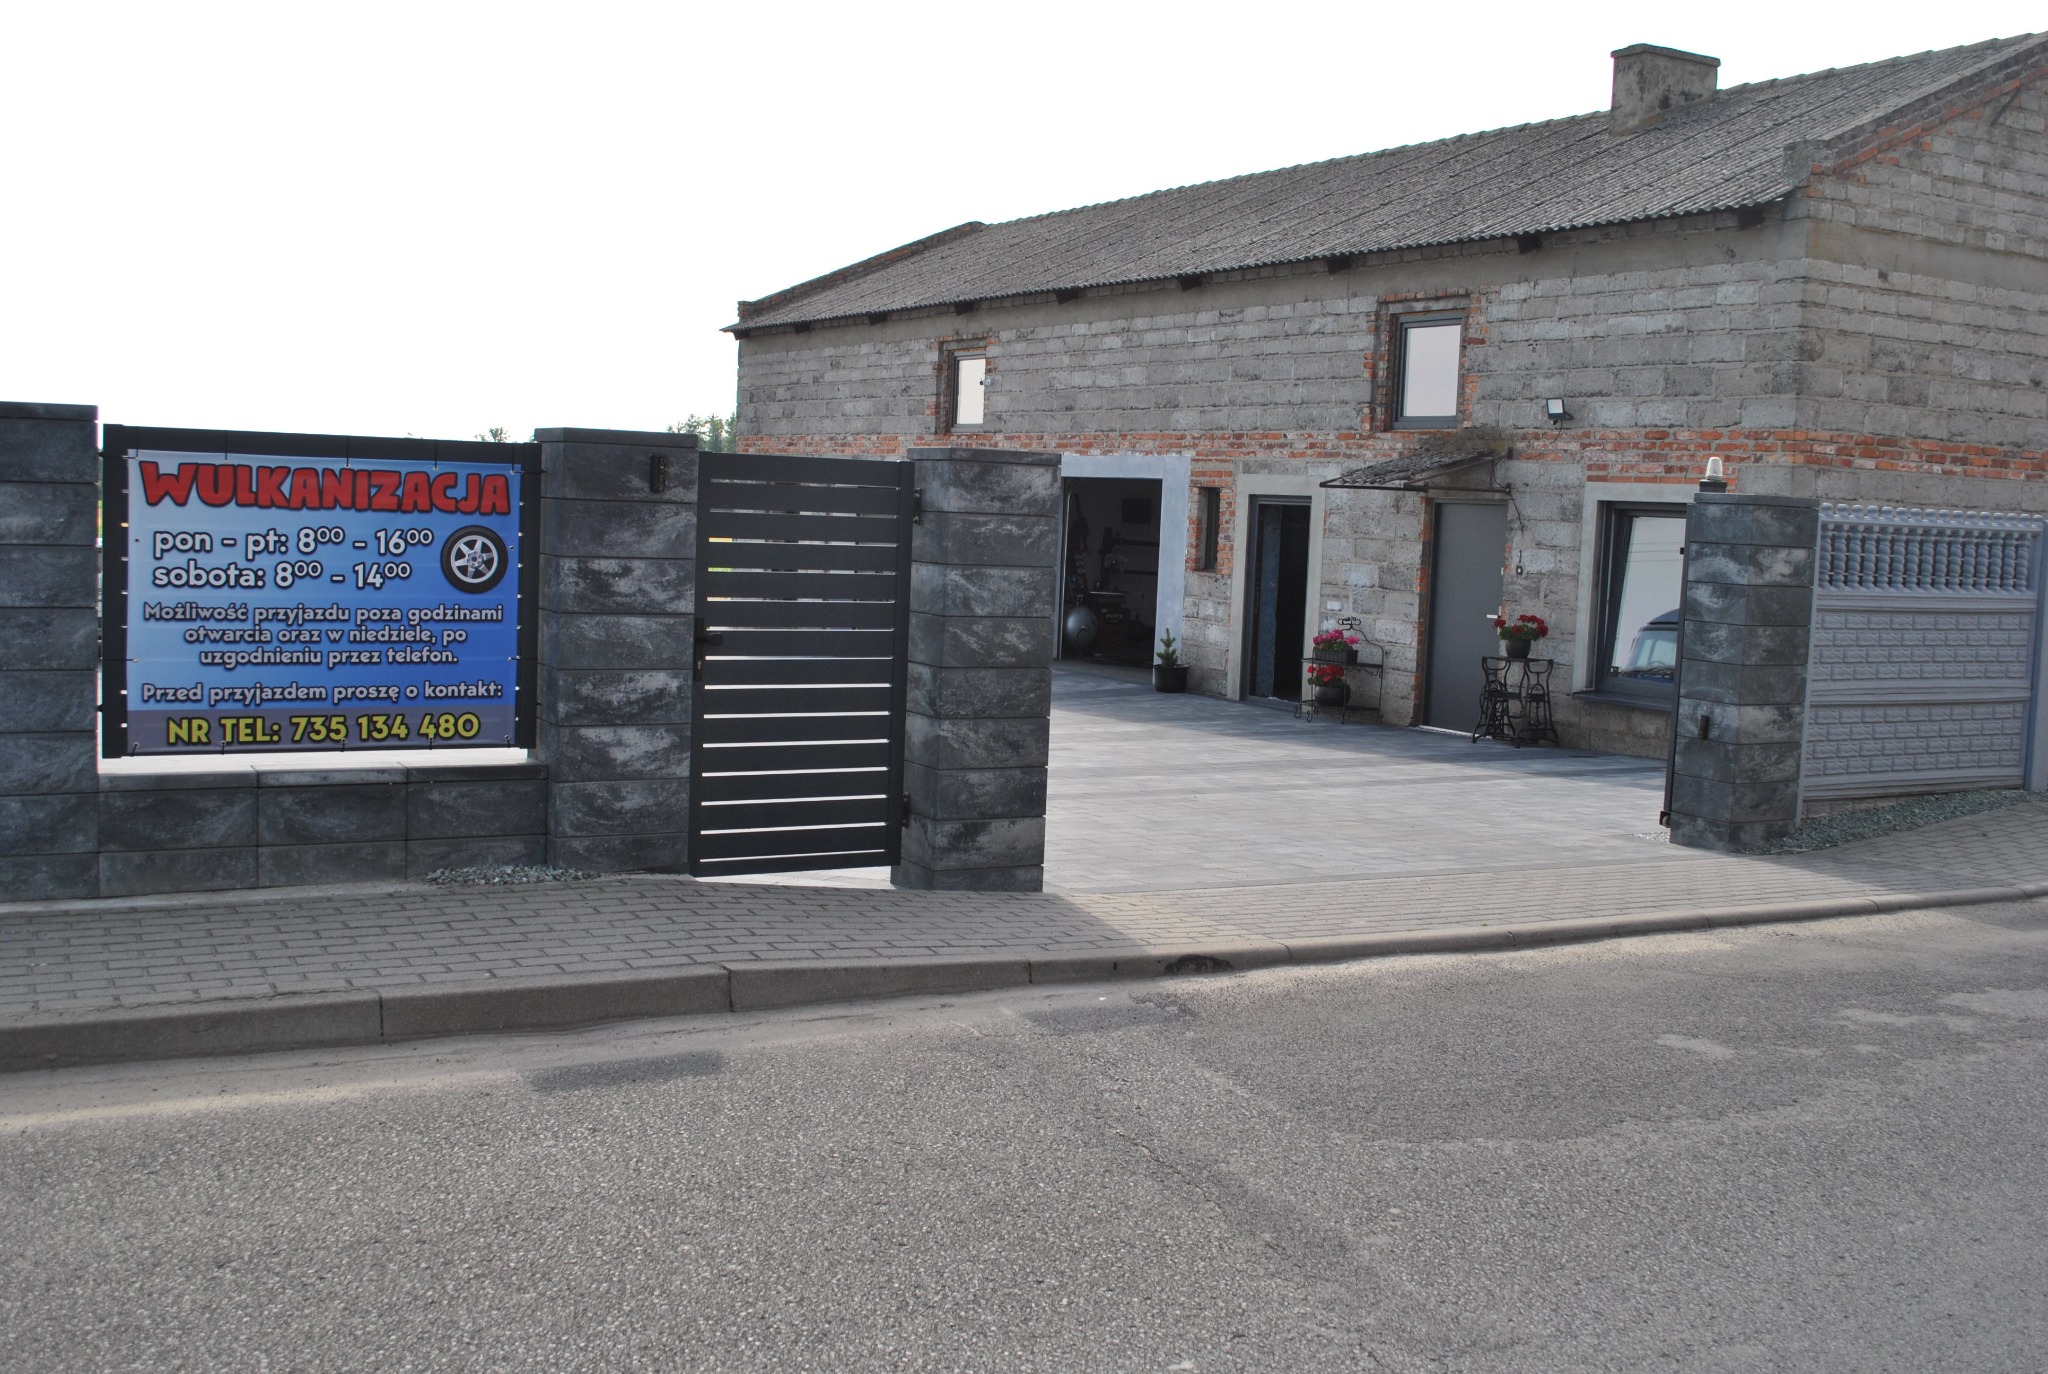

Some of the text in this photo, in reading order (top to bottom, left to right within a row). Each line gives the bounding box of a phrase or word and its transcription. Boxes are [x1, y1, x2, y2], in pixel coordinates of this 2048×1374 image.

[139, 460, 512, 515] WULKANIZACJA
[153, 528, 213, 559] pon
[245, 527, 290, 561] pt:
[152, 560, 266, 588] sobota:
[143, 602, 503, 625] Możliwość przyjazdu poza godzinami
[184, 625, 468, 646] otwarcia oraz w niedziele, po
[200, 647, 459, 669] uzgodnieniu przez telefon.
[142, 680, 503, 705] Przed przyjazdem proszę o kontakt:
[166, 712, 481, 745] NR TEL: 735 134 480
